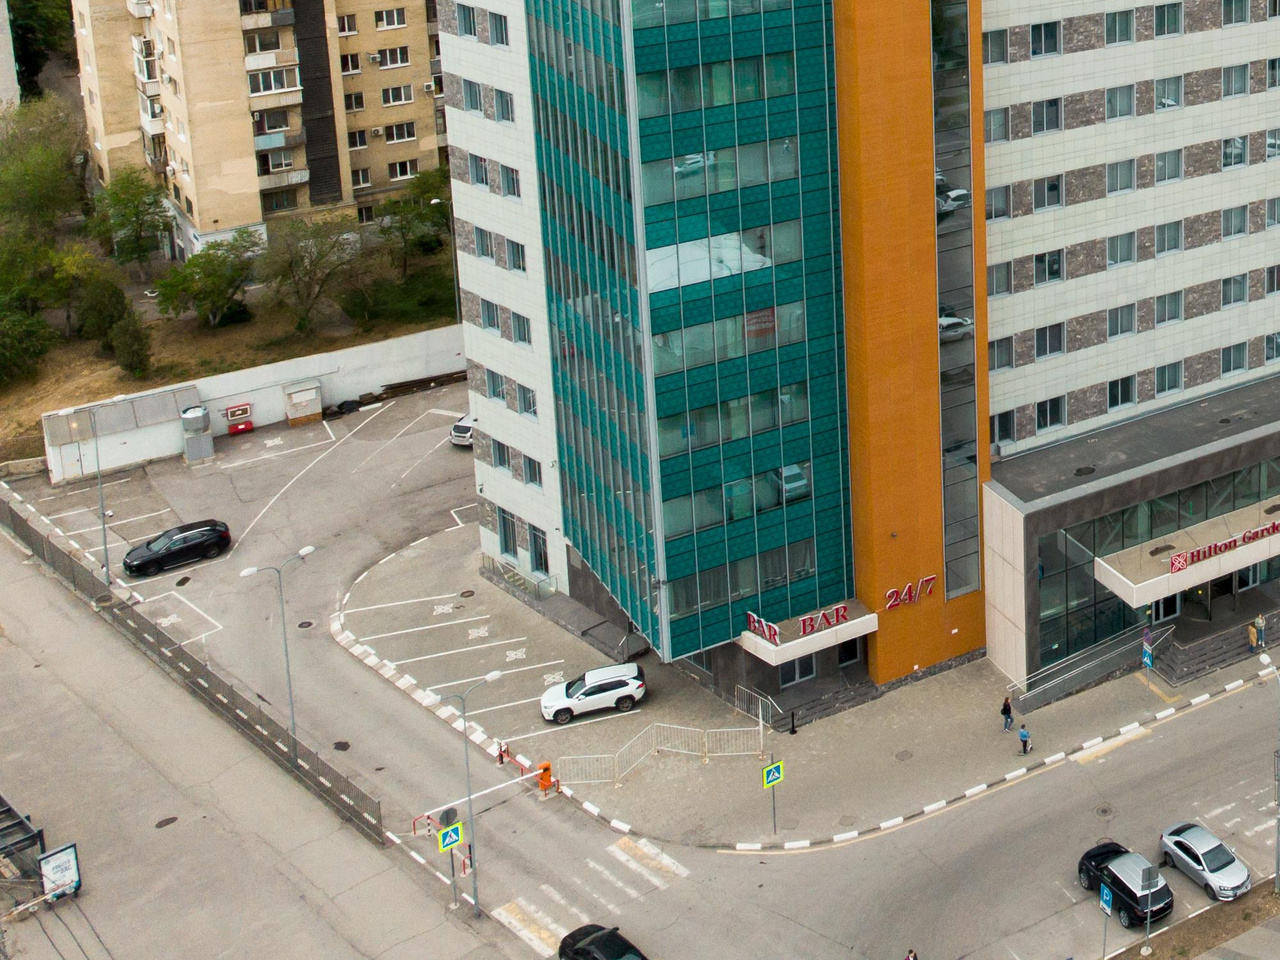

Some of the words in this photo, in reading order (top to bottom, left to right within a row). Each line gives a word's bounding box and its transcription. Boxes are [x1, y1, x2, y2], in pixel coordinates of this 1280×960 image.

[1190, 537, 1238, 565] Hilton
[885, 574, 937, 610] 24/7
[747, 611, 779, 647] BAR
[799, 604, 849, 636] BAR
